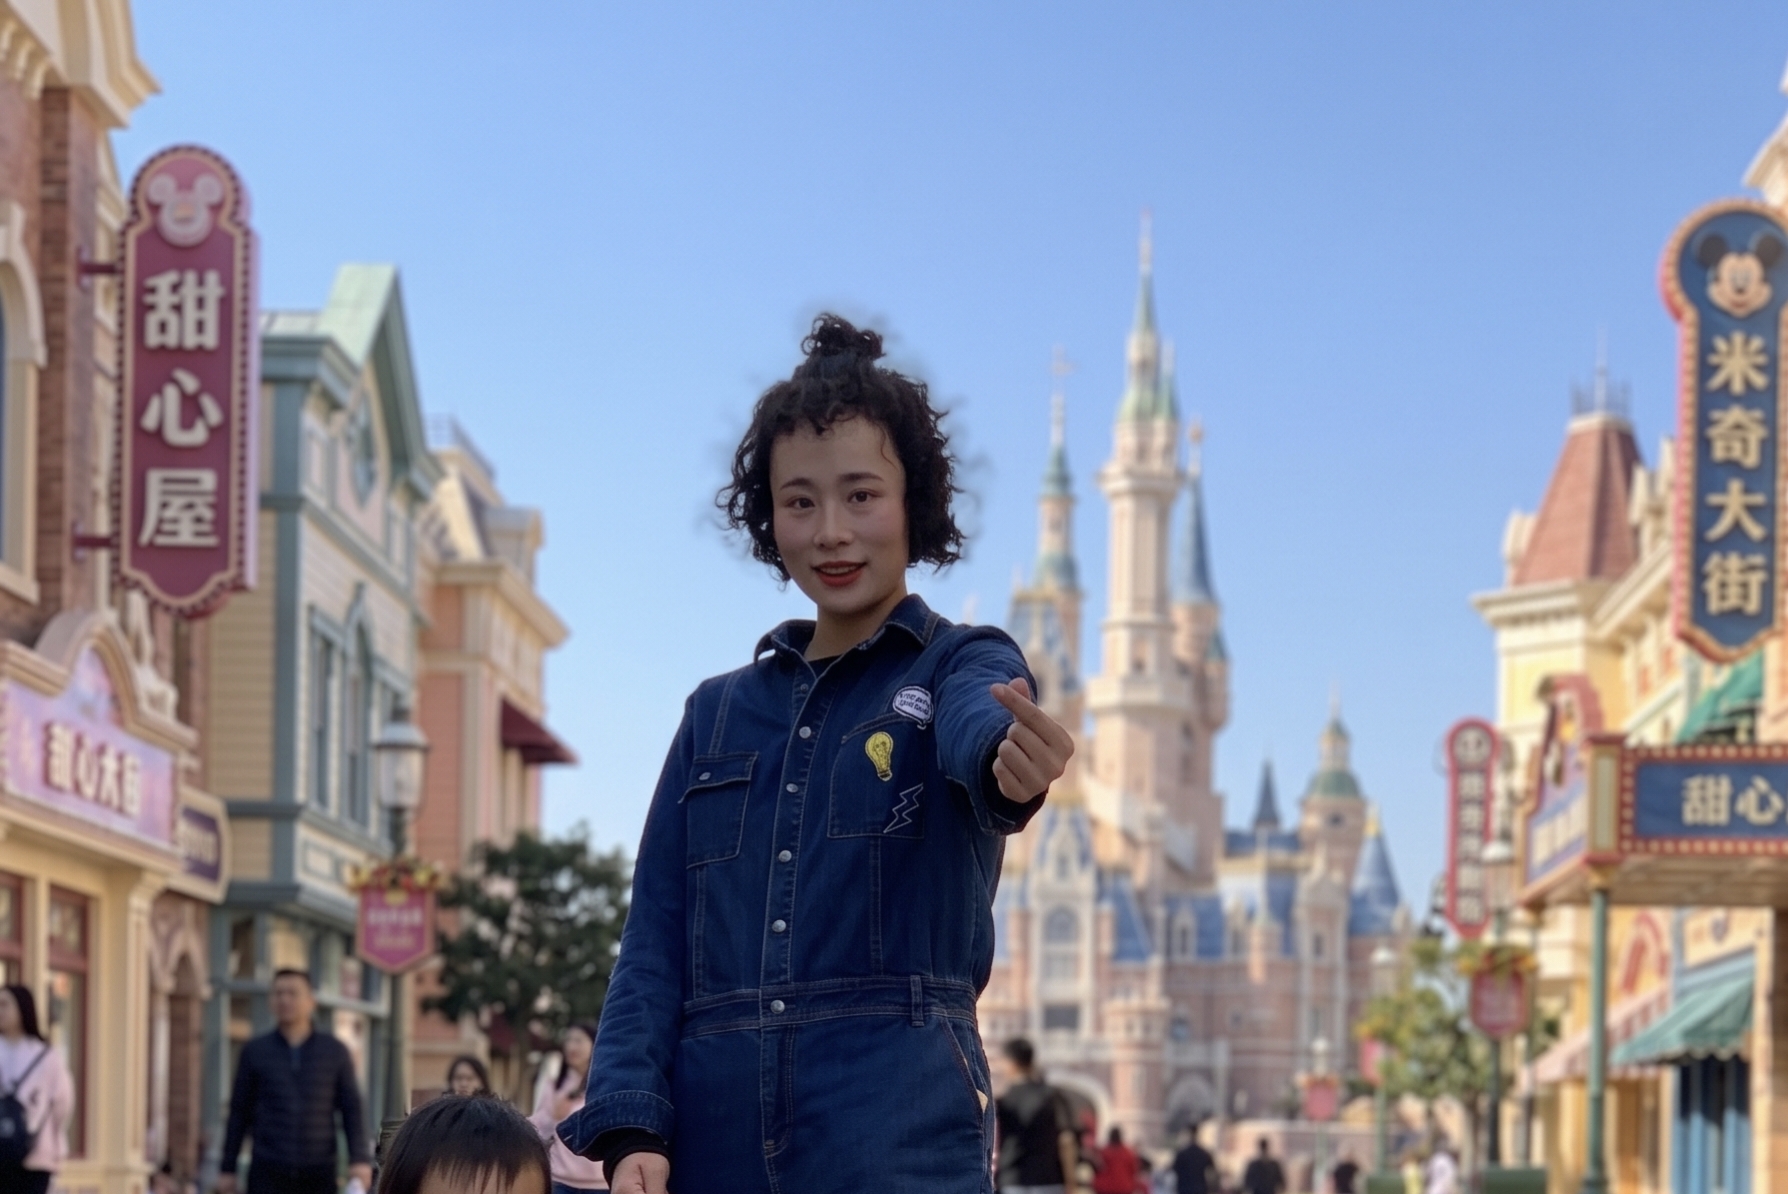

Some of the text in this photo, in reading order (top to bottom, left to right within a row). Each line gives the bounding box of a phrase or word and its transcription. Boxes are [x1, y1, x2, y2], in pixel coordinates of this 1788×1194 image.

[139, 269, 225, 547] 甜心屋
[1703, 331, 1769, 615] 米奇大街
[1681, 774, 1788, 826] 甜心
